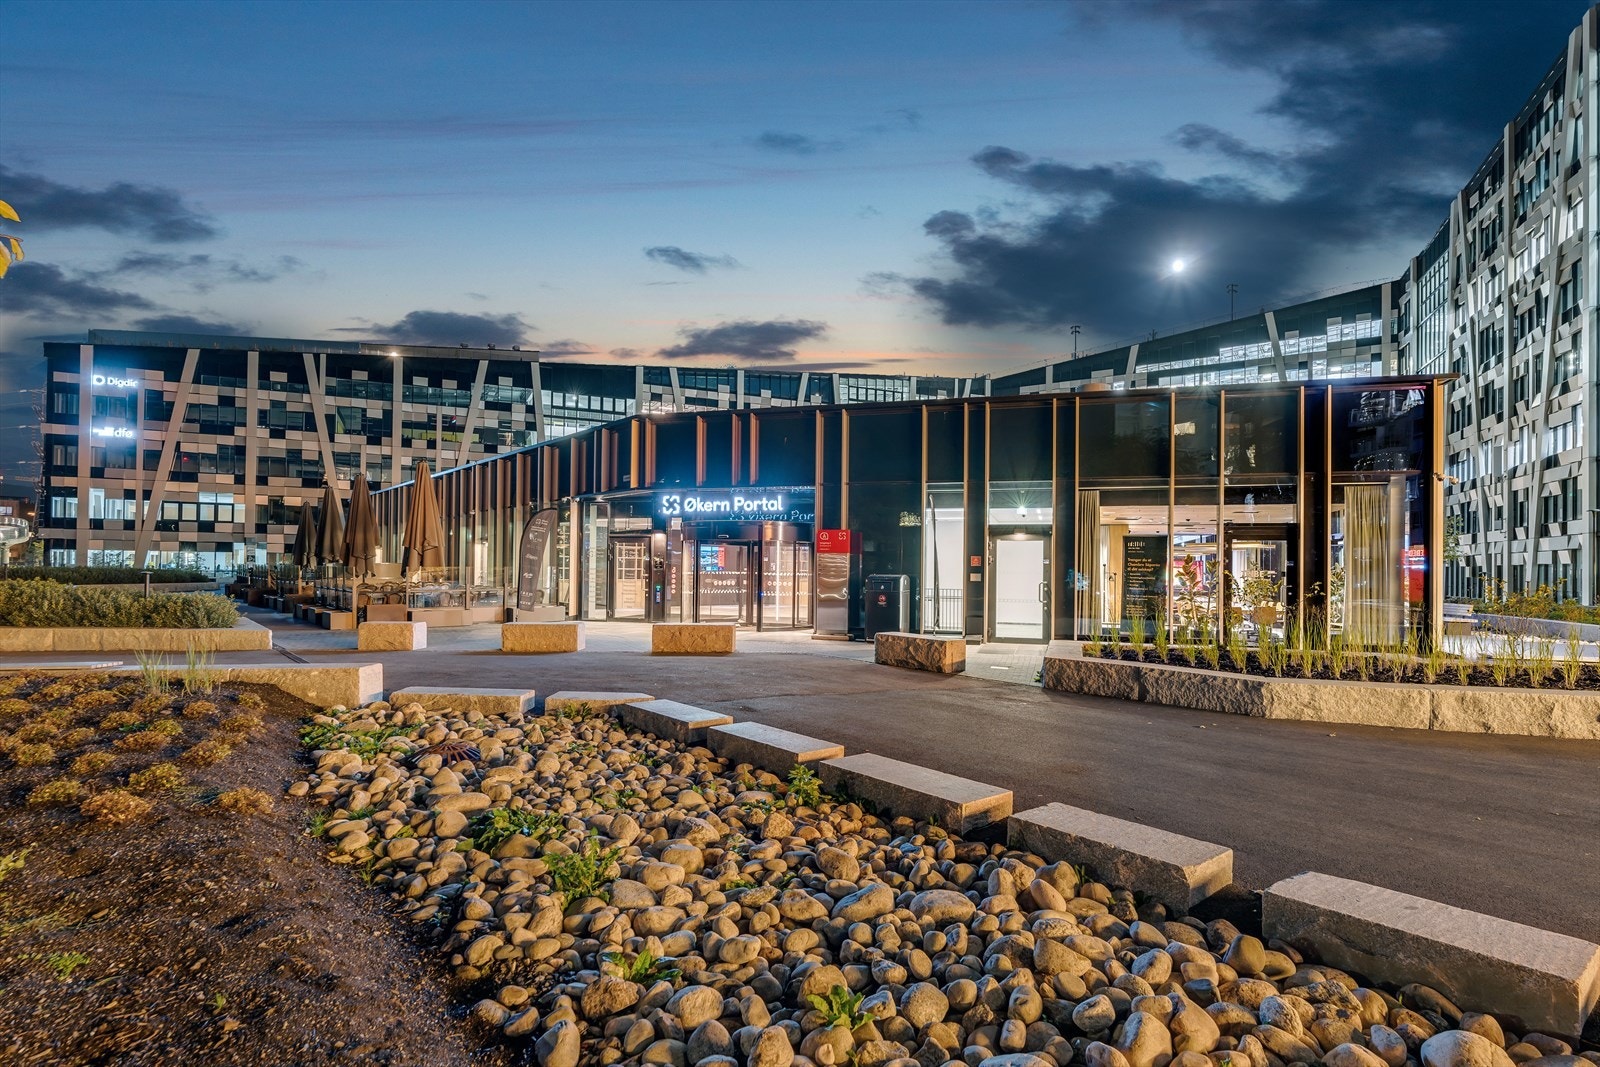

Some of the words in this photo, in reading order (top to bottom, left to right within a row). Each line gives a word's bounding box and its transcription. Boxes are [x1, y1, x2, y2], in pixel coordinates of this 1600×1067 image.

[107, 376, 138, 388] Digdir
[684, 497, 730, 512] Økern
[734, 496, 783, 511] Portal
